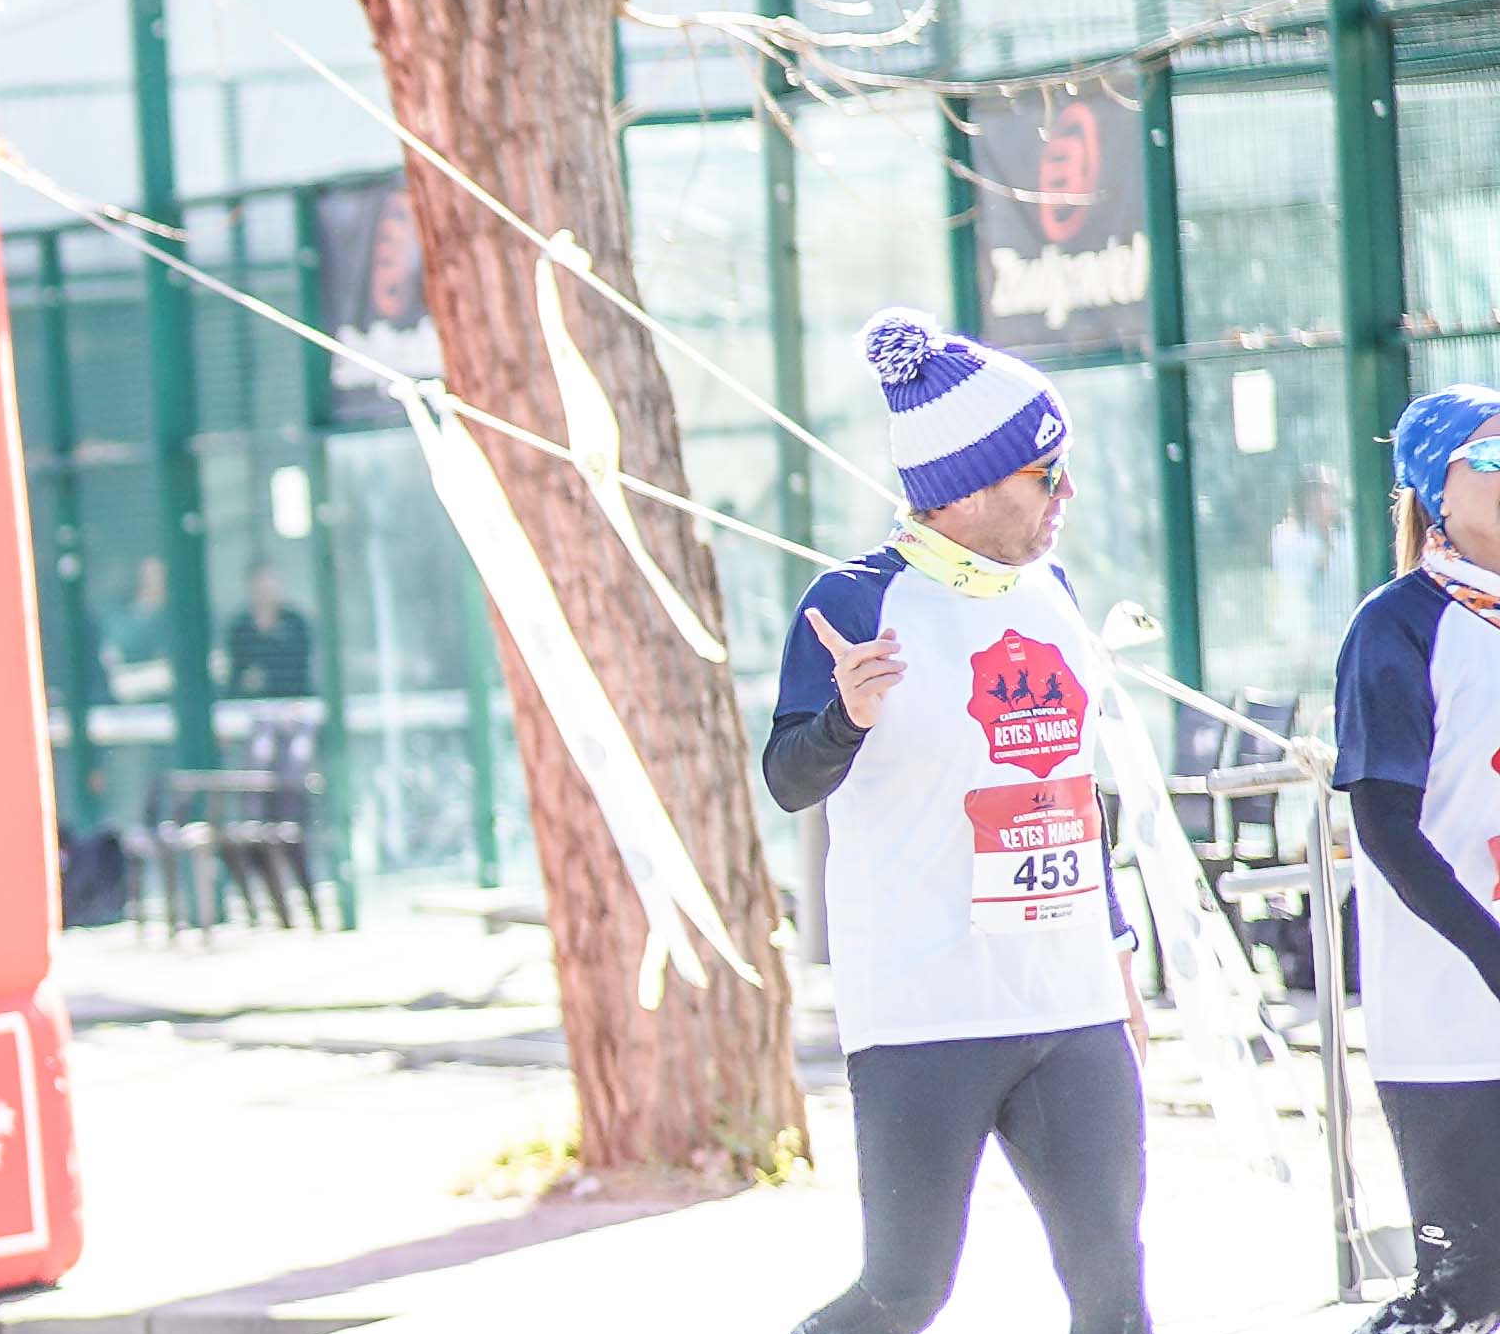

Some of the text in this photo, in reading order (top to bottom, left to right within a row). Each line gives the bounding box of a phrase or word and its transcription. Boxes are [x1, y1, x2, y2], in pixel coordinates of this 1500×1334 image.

[994, 718, 1078, 747] REYES MAGOS
[999, 825, 1045, 849] REYES
[1013, 849, 1080, 892] 453
